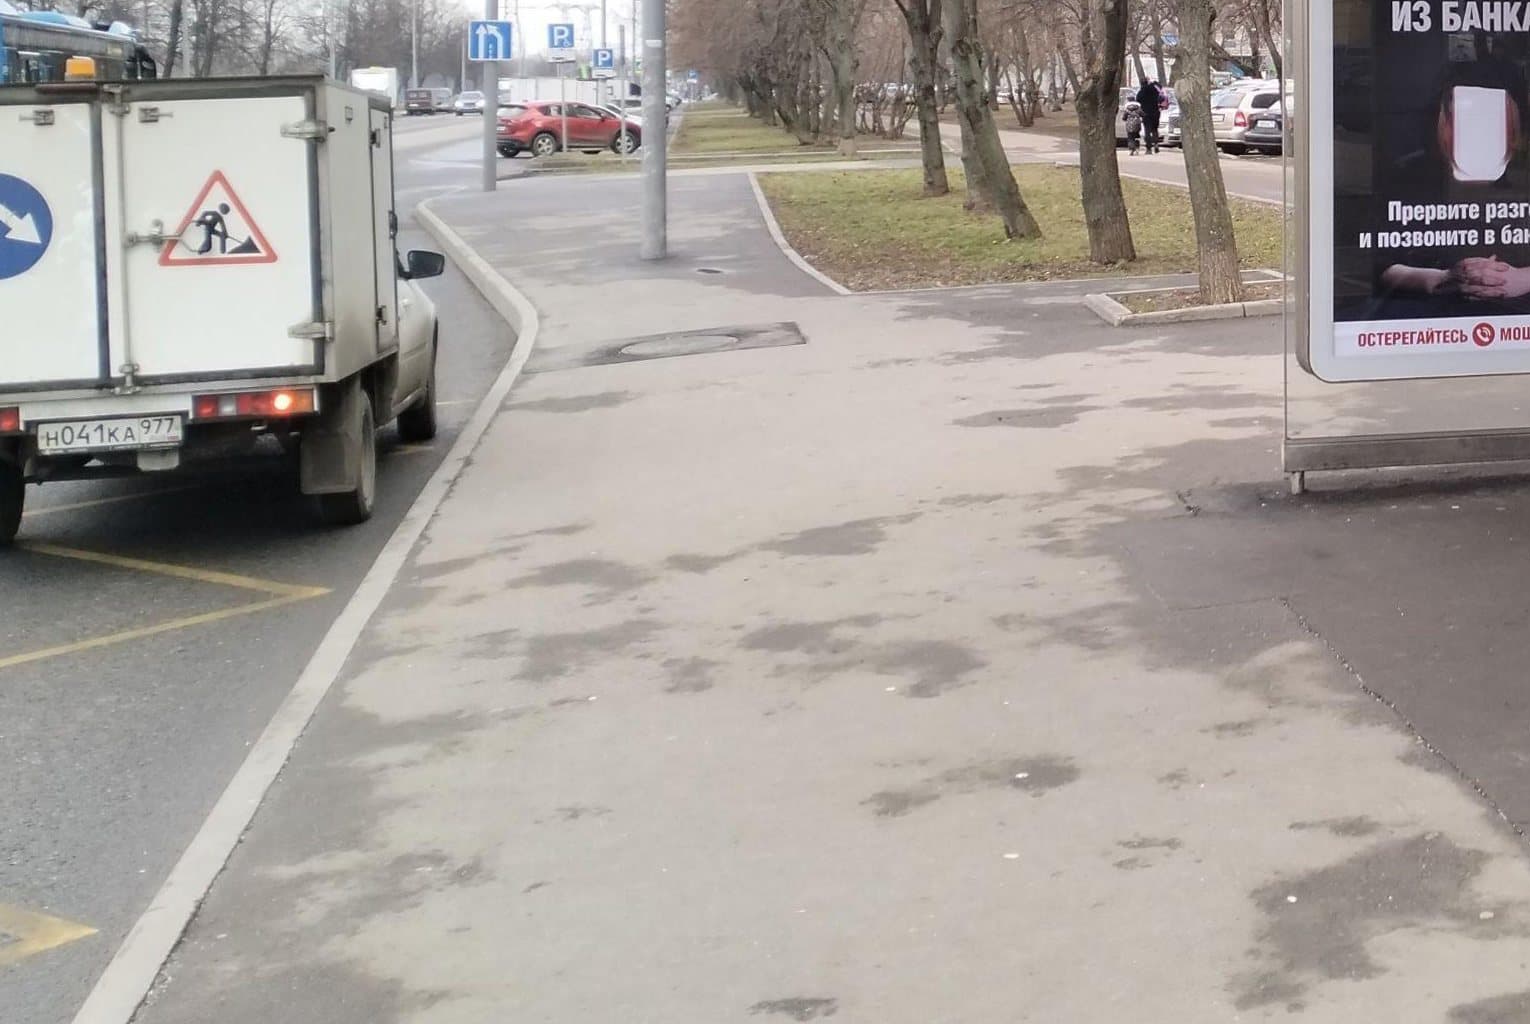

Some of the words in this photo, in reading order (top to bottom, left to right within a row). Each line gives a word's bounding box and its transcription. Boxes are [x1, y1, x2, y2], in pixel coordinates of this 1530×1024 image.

[1391, 1, 1432, 32] ИЗ
[553, 26, 569, 46] P
[598, 51, 610, 66] P
[1388, 201, 1480, 225] Прервите
[1359, 233, 1372, 248] и
[1378, 229, 1479, 248] позвоните
[1484, 229, 1495, 244] в
[1358, 327, 1468, 347] ОСТЕРЕГАЙТЕСЬ
[46, 423, 136, 447] Н041КА
[140, 417, 174, 435] 977
